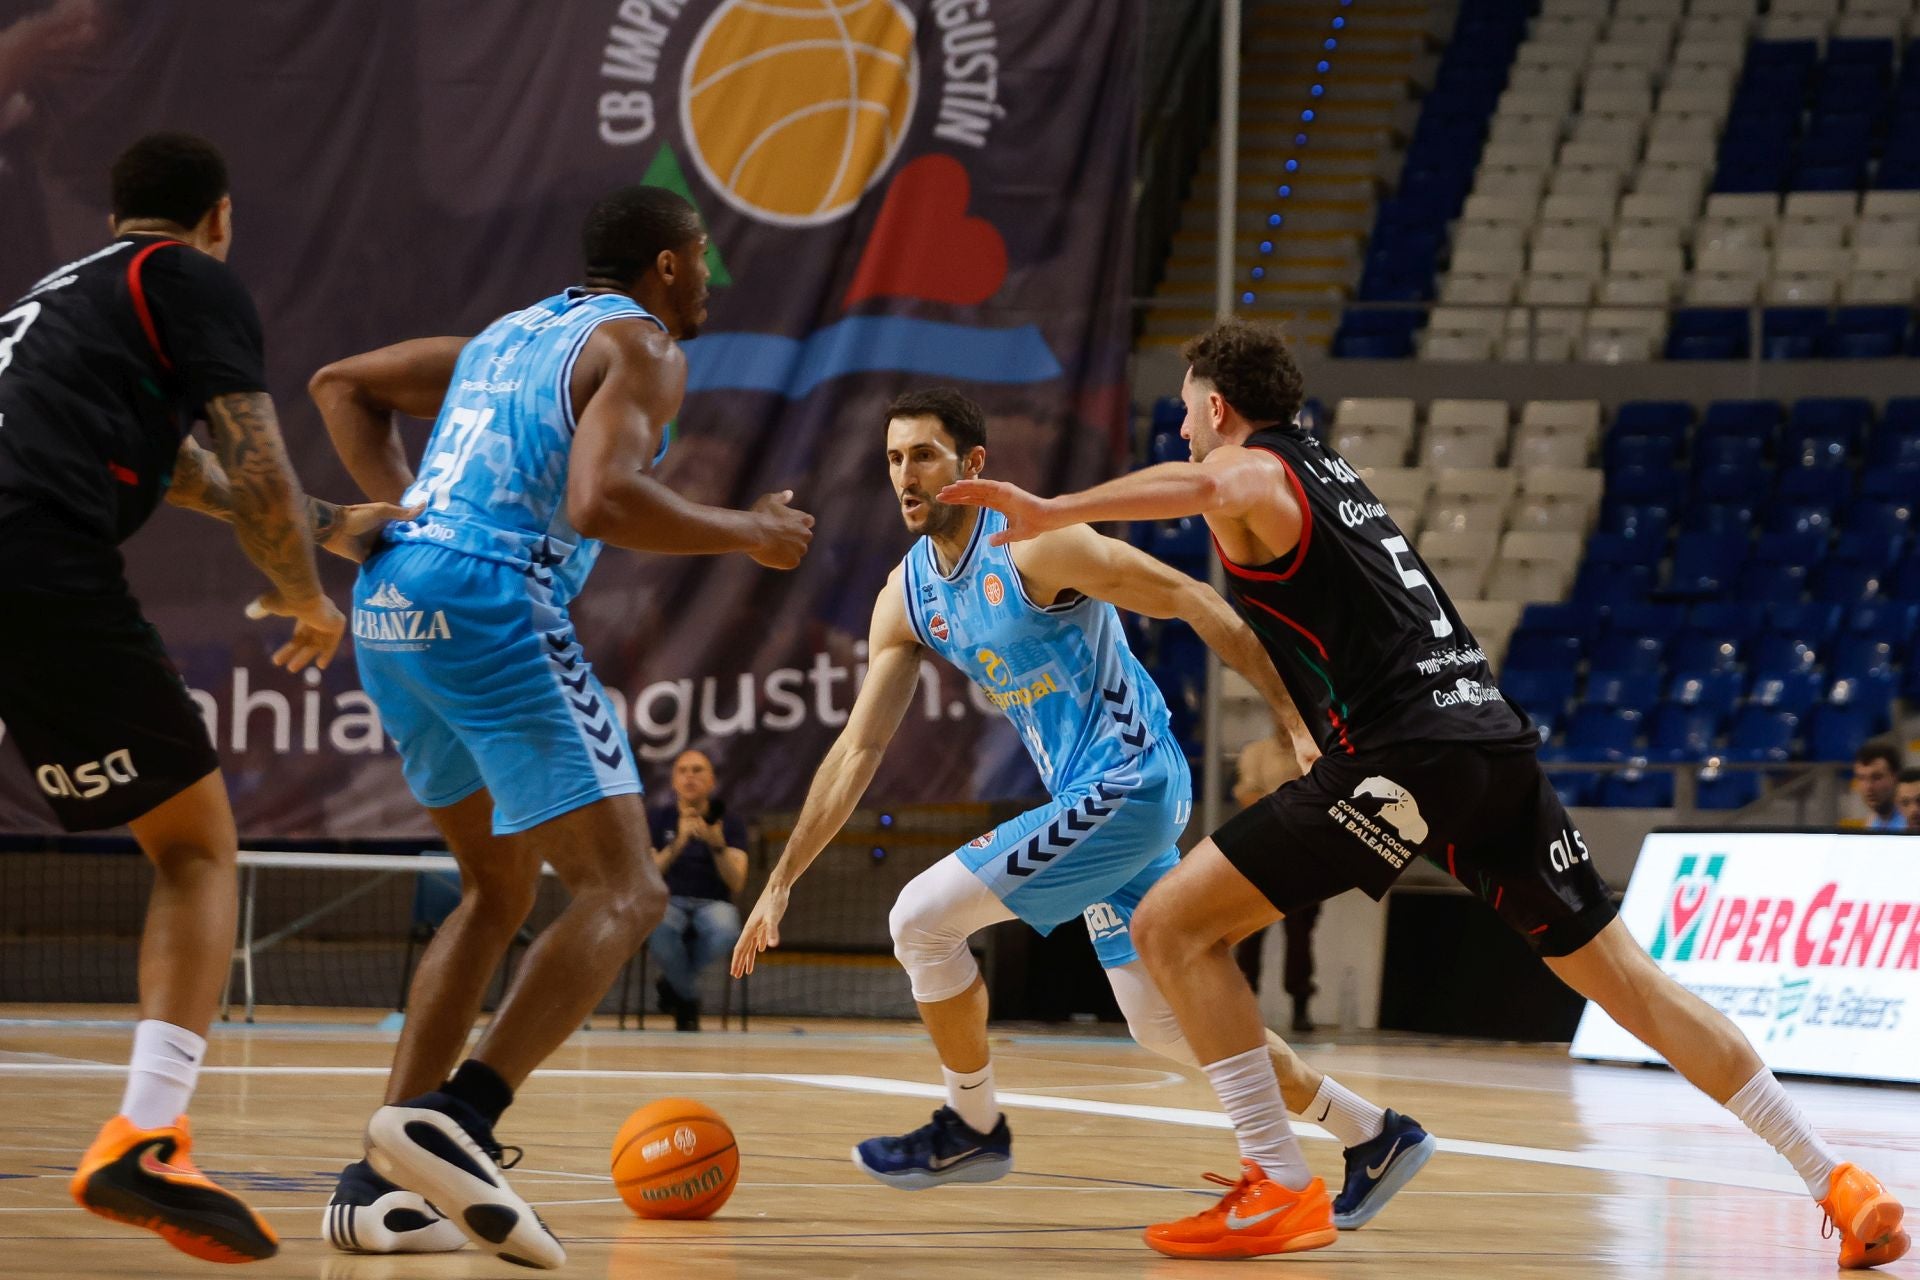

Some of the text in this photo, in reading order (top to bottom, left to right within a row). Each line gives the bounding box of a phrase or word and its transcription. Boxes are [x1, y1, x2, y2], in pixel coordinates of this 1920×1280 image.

[1380, 534, 1453, 638] 5
[1327, 805, 1404, 869] EN BALEARES
[1337, 800, 1412, 860] COMPRAR COCHE
